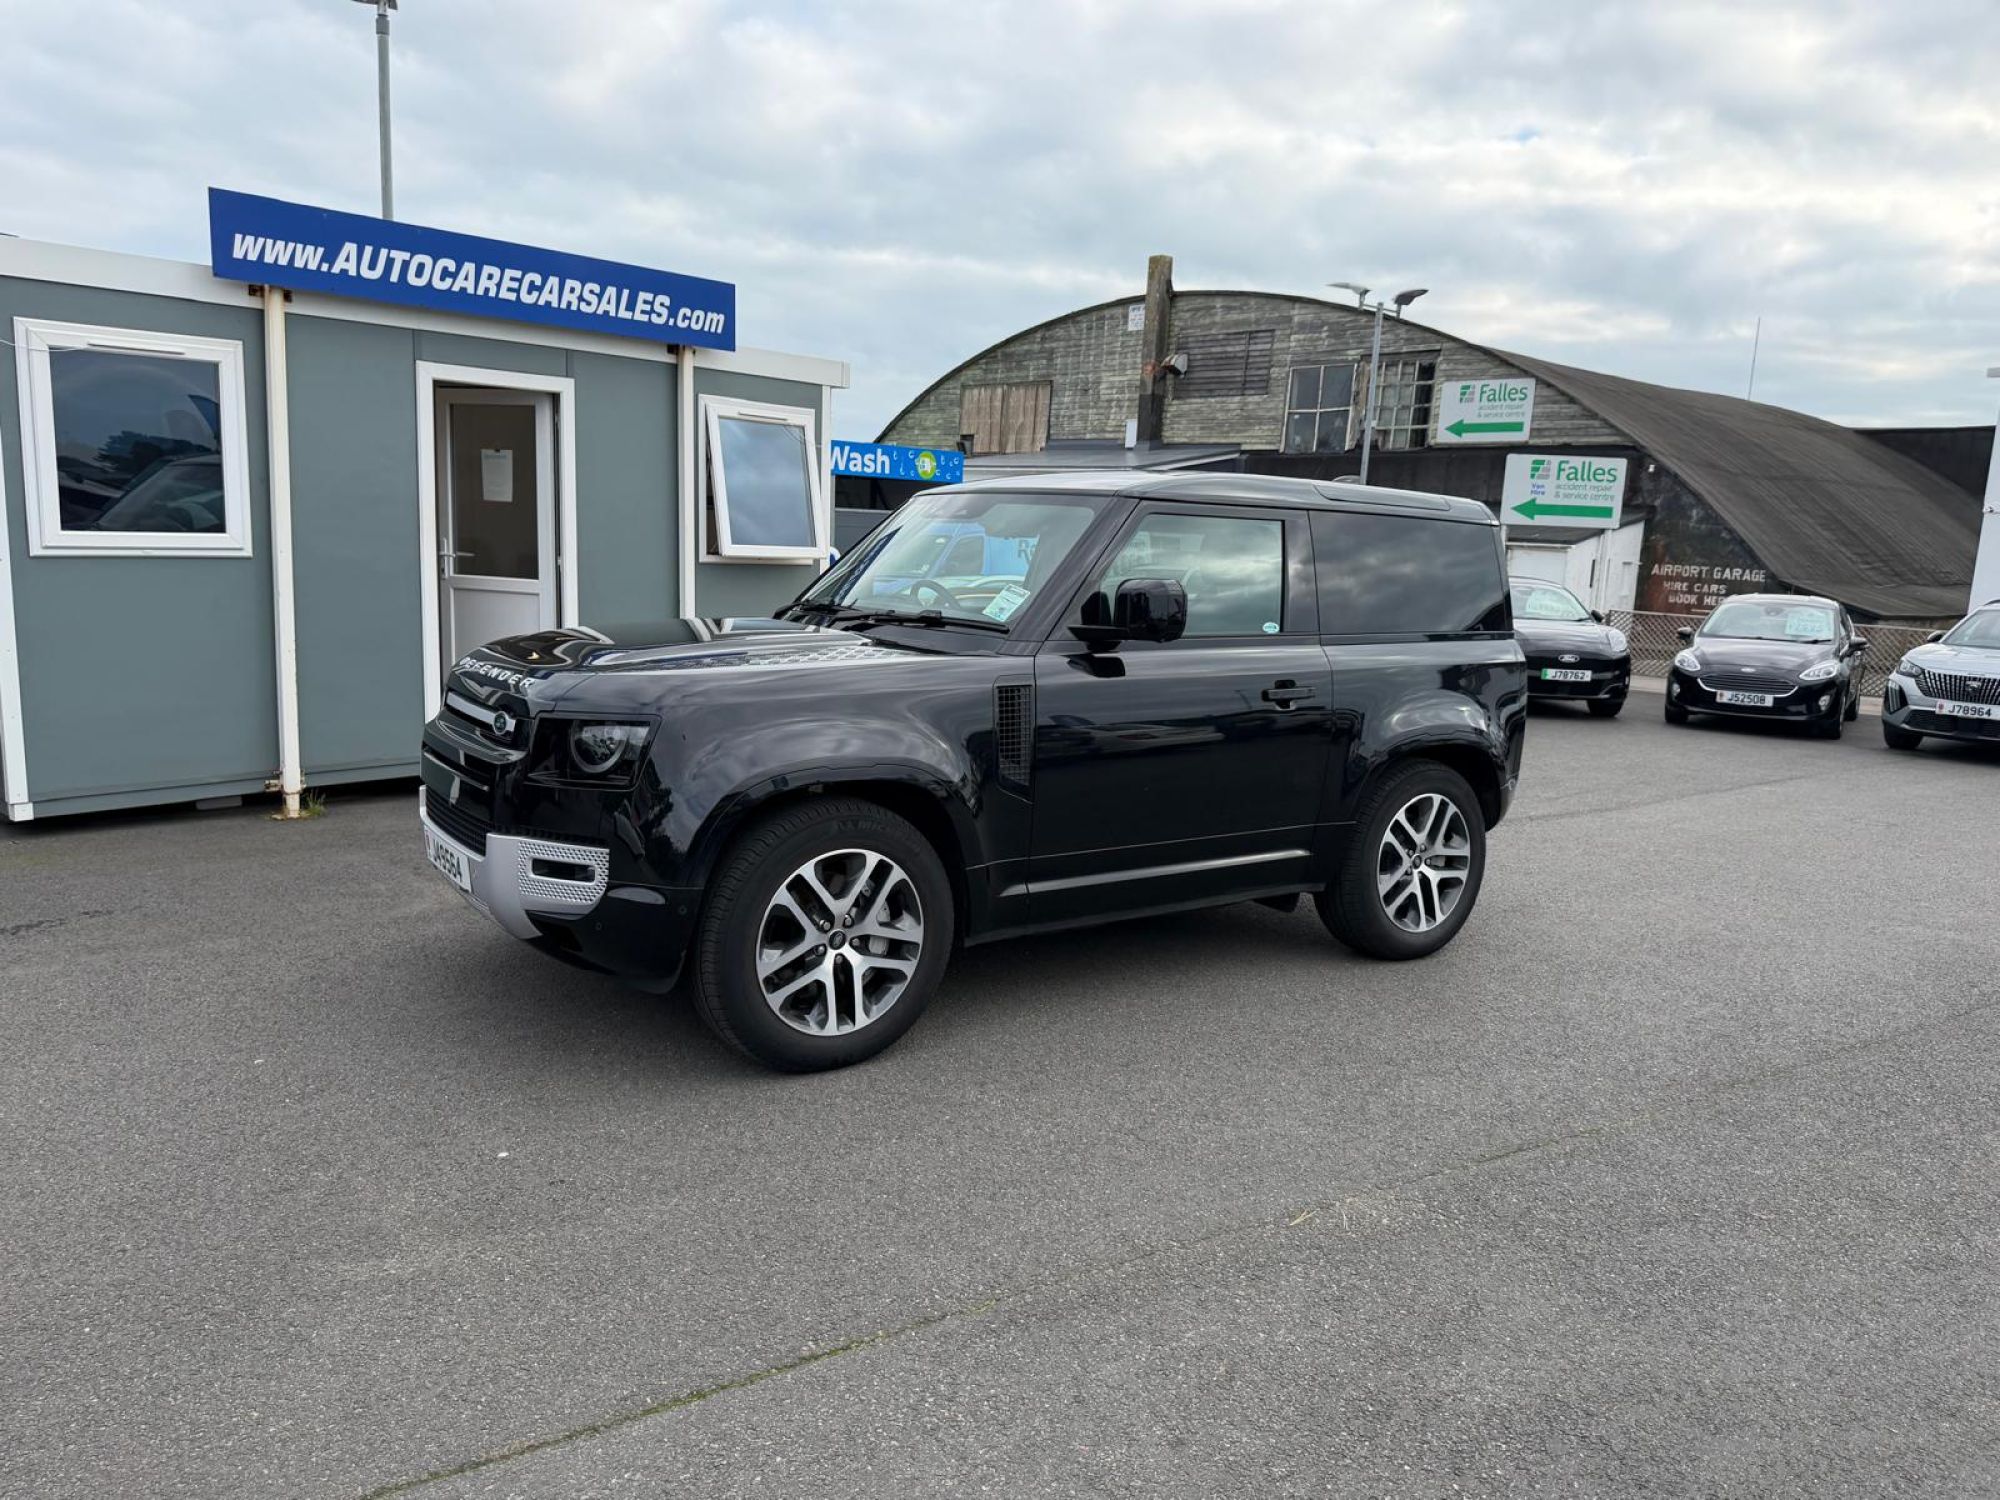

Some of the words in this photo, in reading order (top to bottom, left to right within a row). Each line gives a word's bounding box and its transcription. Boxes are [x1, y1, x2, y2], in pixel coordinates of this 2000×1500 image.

[232, 232, 726, 335] www.AUTOCARECARSALES.com
[1479, 383, 1528, 402] Falles
[831, 445, 890, 475] Wash
[1556, 460, 1618, 483] Falles
[1651, 564, 1710, 578] AIRPORT
[1713, 567, 1766, 583] GARAGE
[1693, 583, 1728, 594] CARS
[460, 656, 536, 688] DEFENDER
[1949, 704, 1992, 717] J78964
